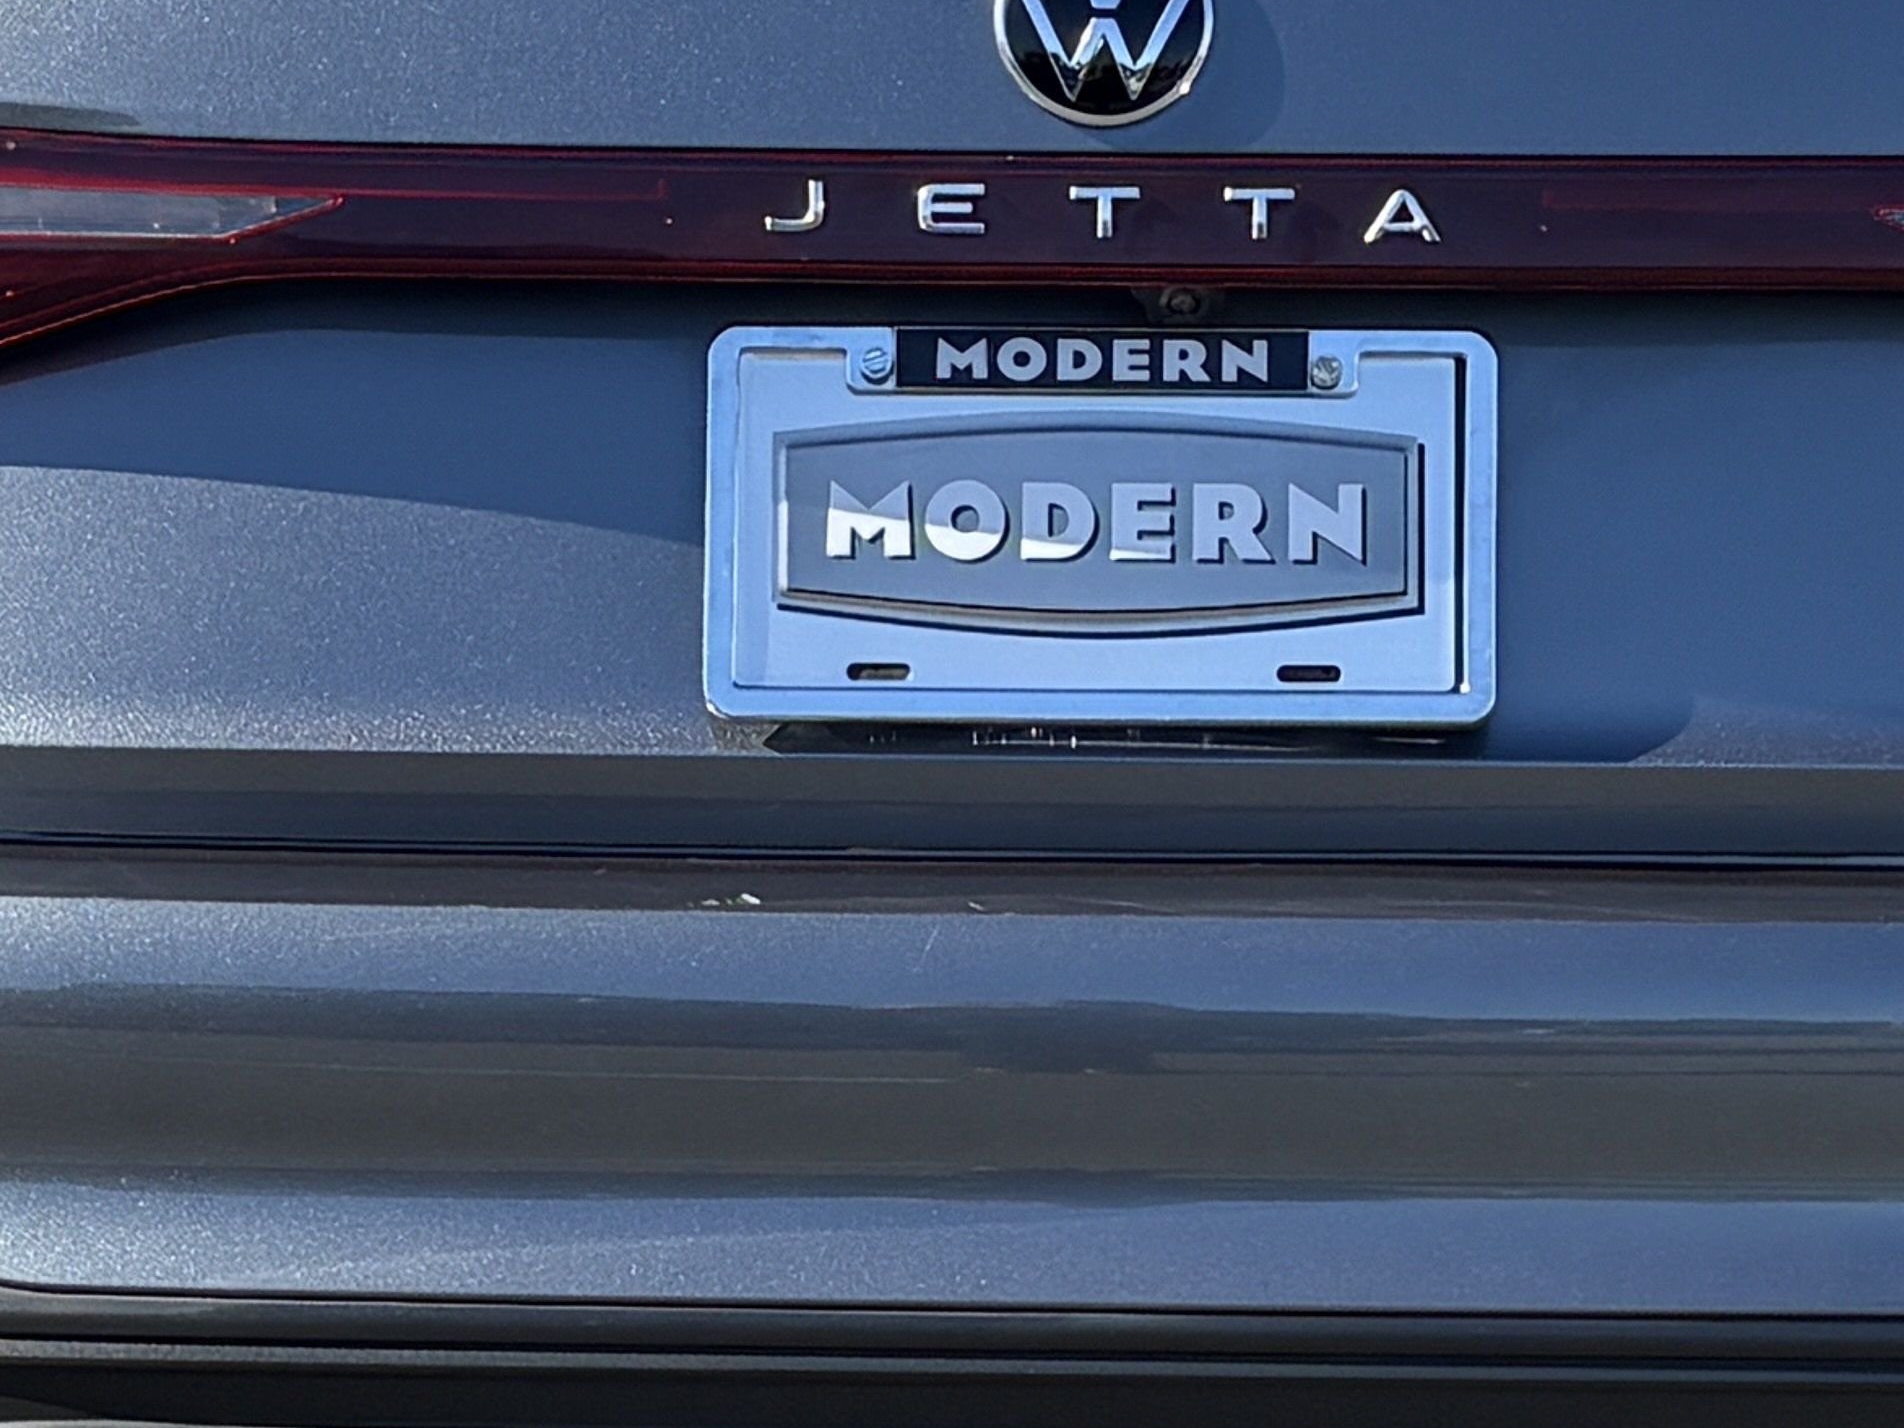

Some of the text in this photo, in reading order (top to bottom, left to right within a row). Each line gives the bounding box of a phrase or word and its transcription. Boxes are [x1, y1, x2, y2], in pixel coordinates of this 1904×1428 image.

[763, 178, 1442, 244] JETTA
[934, 335, 1271, 386] MODERN
[823, 477, 1370, 566] MODERN
